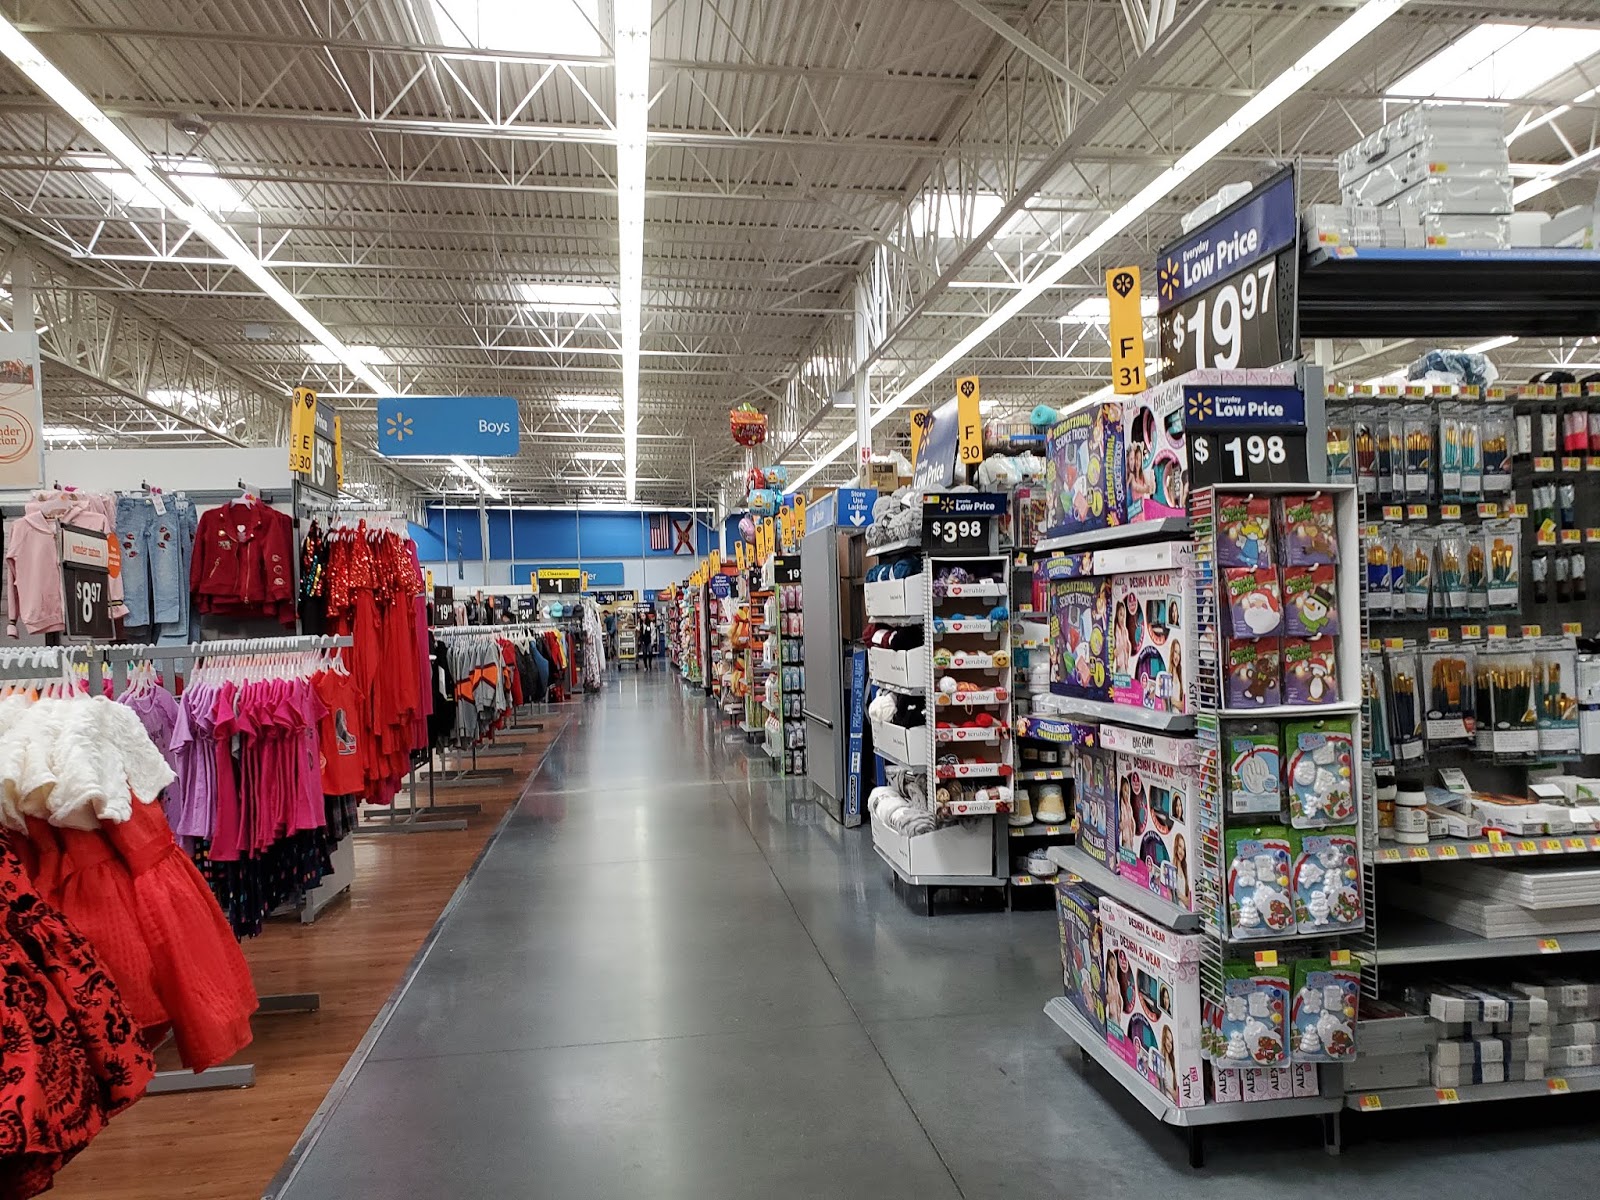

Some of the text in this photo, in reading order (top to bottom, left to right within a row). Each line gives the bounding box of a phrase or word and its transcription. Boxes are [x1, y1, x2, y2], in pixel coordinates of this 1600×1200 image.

[1183, 240, 1209, 266] Everyday
[1183, 227, 1258, 289] Low Price
[1120, 337, 1135, 359] F
[1120, 367, 1140, 386] 31
[1215, 401, 1284, 417] Low Price
[479, 419, 511, 436] Boys
[965, 425, 975, 440] F
[293, 434, 298, 448] E
[303, 435, 310, 450] E
[962, 446, 980, 460] 30
[299, 456, 311, 470] 30
[1106, 435, 1116, 508] SENSATIONAL
[928, 461, 944, 485] Price
[956, 500, 995, 511] Low Price
[784, 528, 789, 536] F
[798, 520, 803, 528] F
[1130, 574, 1170, 588] DESIGN & WEAR
[1132, 736, 1142, 748] BIG
[1134, 757, 1151, 772] DESIGN
[1152, 762, 1157, 774] &
[1158, 764, 1174, 780] WEAR
[1105, 926, 1116, 938] ALEX
[1128, 917, 1144, 933] DESIGN
[1146, 924, 1150, 936] &
[1152, 929, 1166, 944] WEAR
[1120, 934, 1138, 954] DESIGN
[1140, 946, 1144, 958] &
[1145, 950, 1162, 970] WEAR
[1219, 1069, 1228, 1094] ALEX
[1246, 1068, 1256, 1094] ALEX
[1270, 1066, 1280, 1091] ALEX
[1298, 1063, 1306, 1088] ALEX
[1182, 1074, 1191, 1100] ALEX
